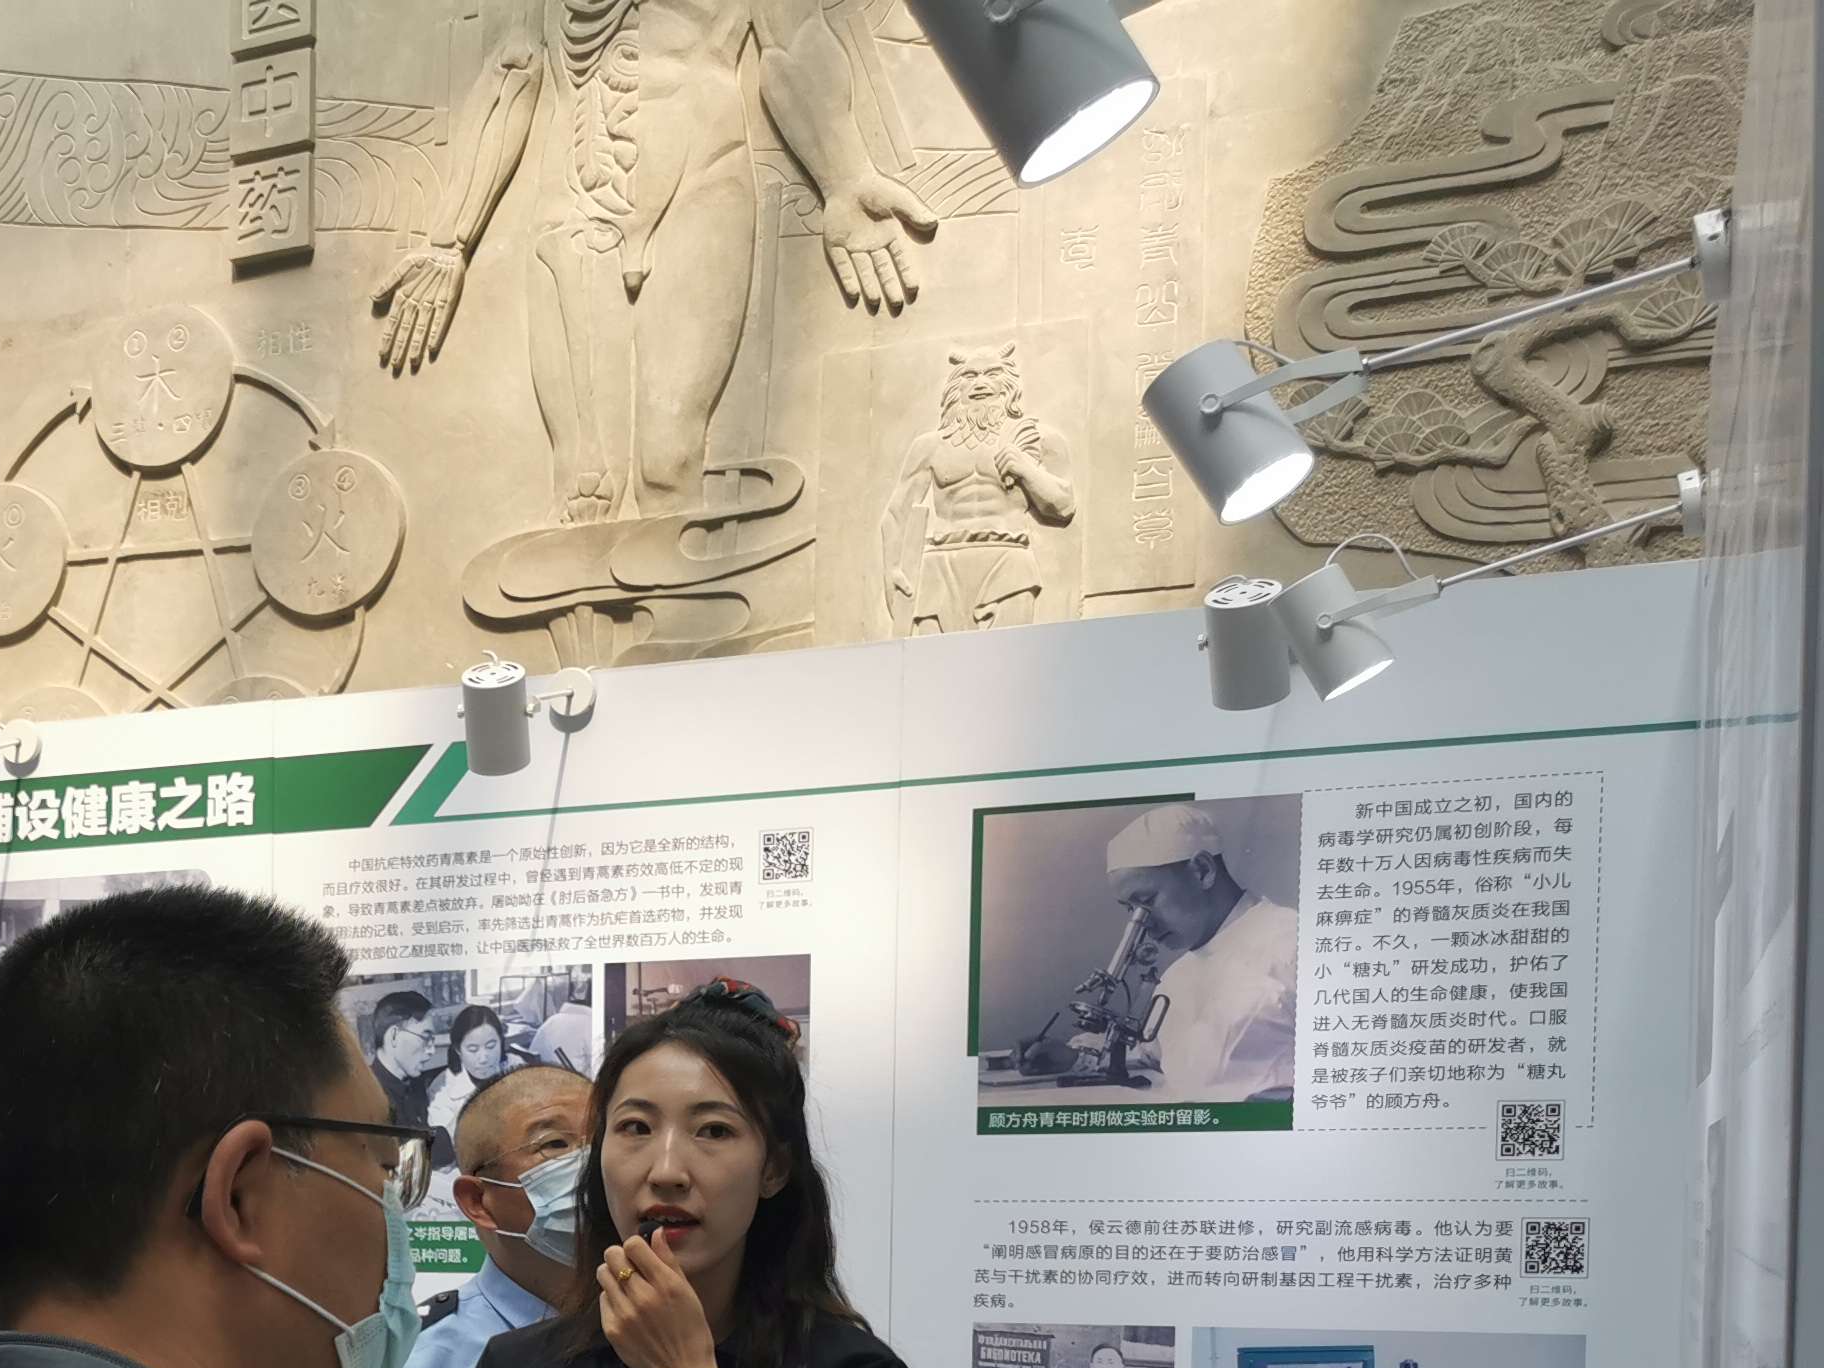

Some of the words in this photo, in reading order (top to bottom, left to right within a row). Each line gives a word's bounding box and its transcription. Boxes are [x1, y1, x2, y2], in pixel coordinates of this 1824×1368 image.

[1354, 790, 1574, 820] 新中国成立之初，国内的
[1318, 817, 1574, 848] 病毒学研究仍属初创阶段，每
[1317, 845, 1572, 875] 年数十万人因病毒性疾病而失
[1314, 927, 1570, 954] 流行。不久，一颗冰冰甜甜的
[1313, 981, 1569, 1006] 几代国人的生命健康，使我国
[1312, 1008, 1568, 1032] 进入无脊髓灰质炎时代。口服
[1312, 1035, 1568, 1059] 脊髓灰质炎疫苗的研发者，就
[988, 1109, 1220, 1128] 顾方舟青年时期做实验时留影。
[973, 1293, 1015, 1308] 疾病。
